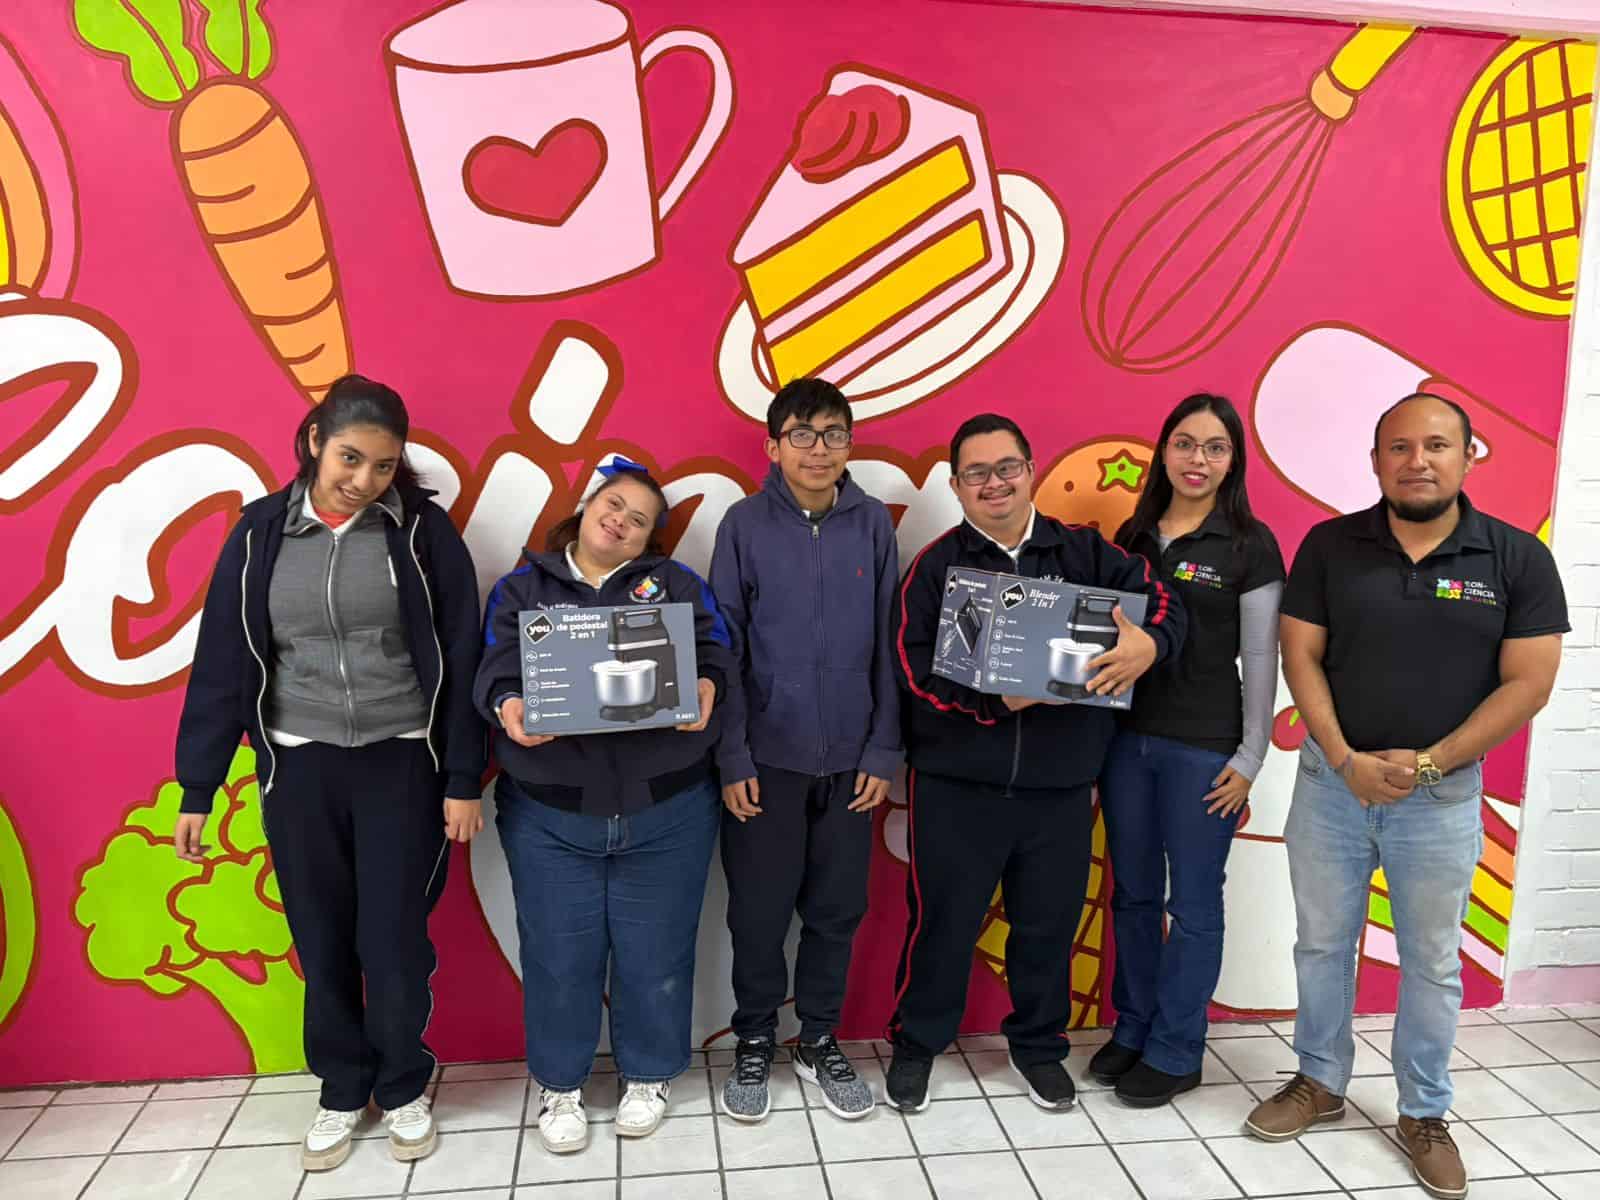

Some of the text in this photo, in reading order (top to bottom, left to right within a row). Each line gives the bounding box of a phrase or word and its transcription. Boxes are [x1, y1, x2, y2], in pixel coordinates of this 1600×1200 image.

[1004, 591, 1023, 601] you
[1029, 588, 1060, 600] Blender
[562, 613, 601, 622] Batidora
[529, 625, 550, 636] you
[556, 621, 608, 632] de pedestal
